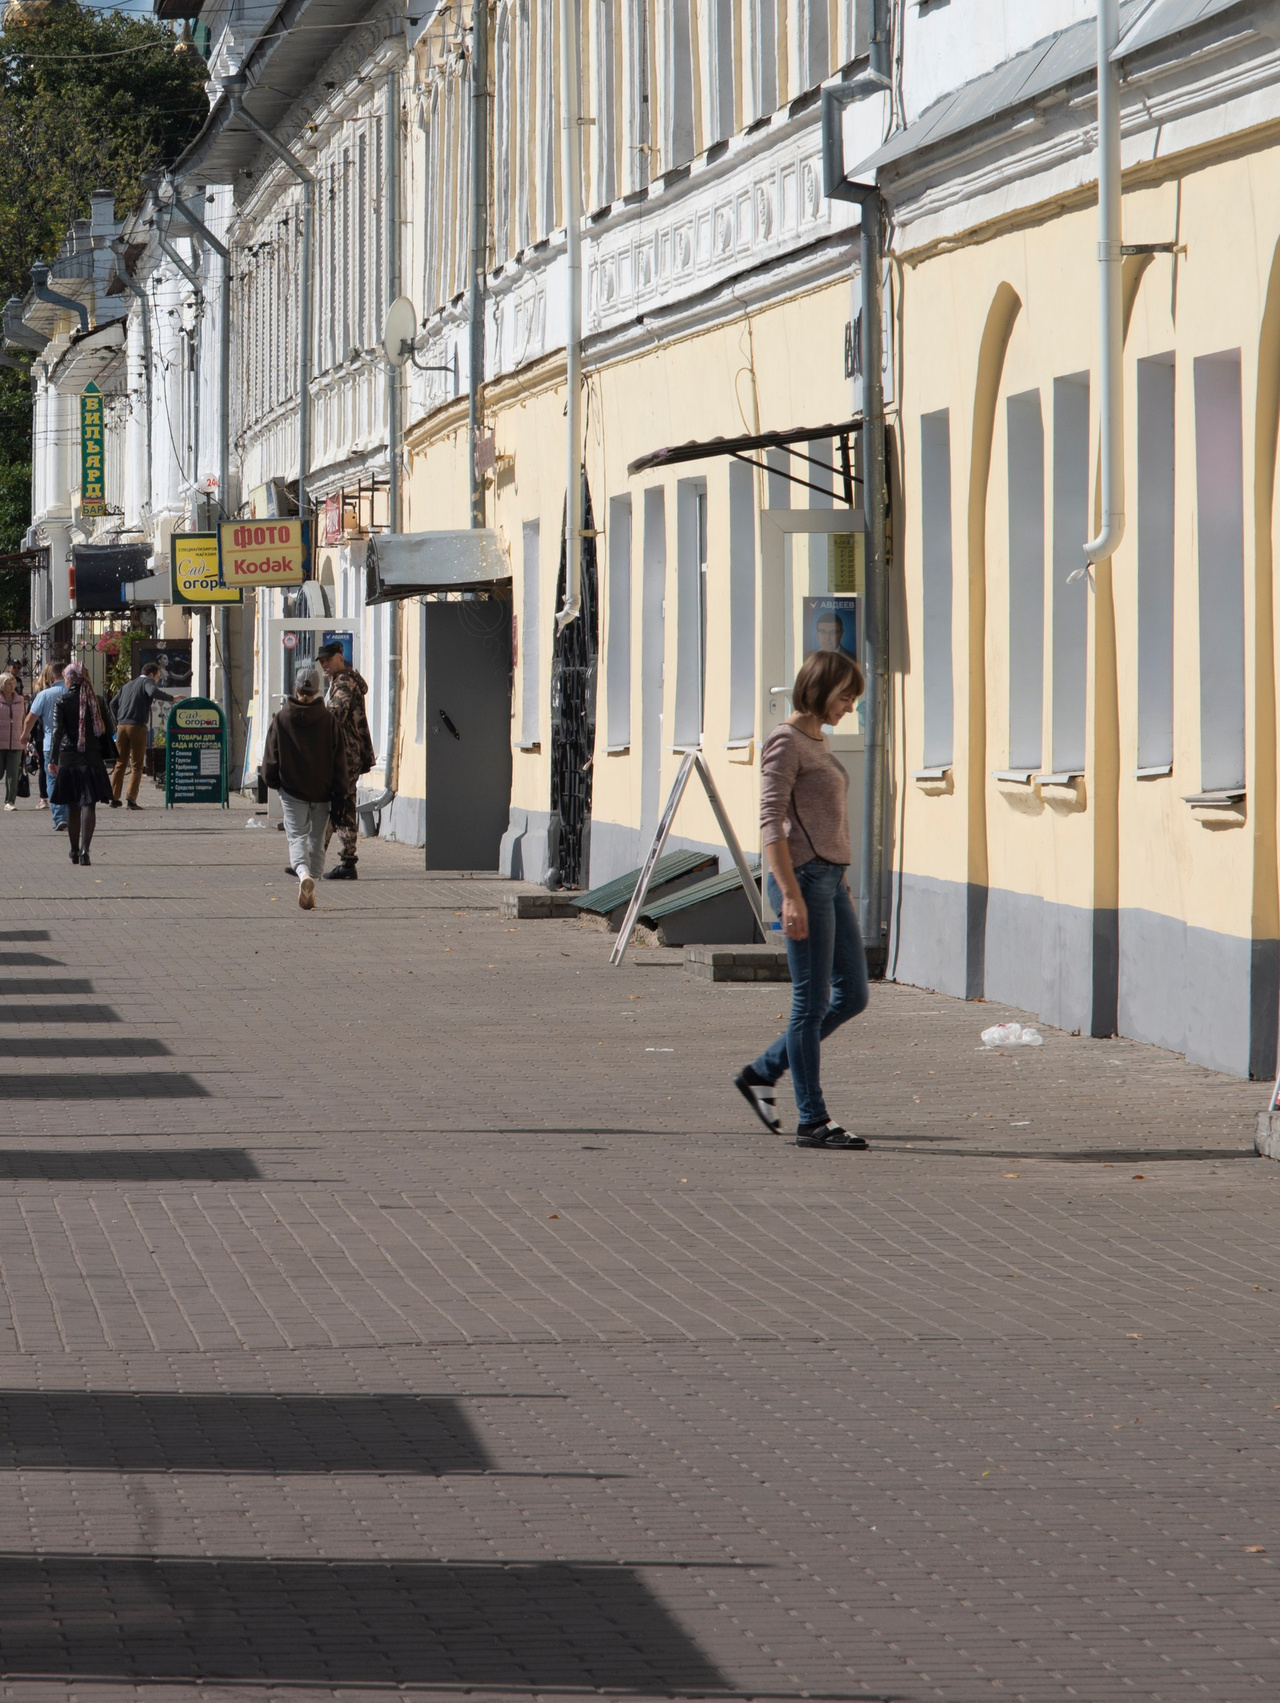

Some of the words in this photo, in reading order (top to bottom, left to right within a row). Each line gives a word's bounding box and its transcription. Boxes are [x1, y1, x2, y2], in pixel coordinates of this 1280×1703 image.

[84, 398, 101, 497] БИЛЬЯРД
[82, 505, 103, 515] БАР
[234, 556, 294, 575] Kodak
[820, 601, 855, 609] АВДЕЕВ
